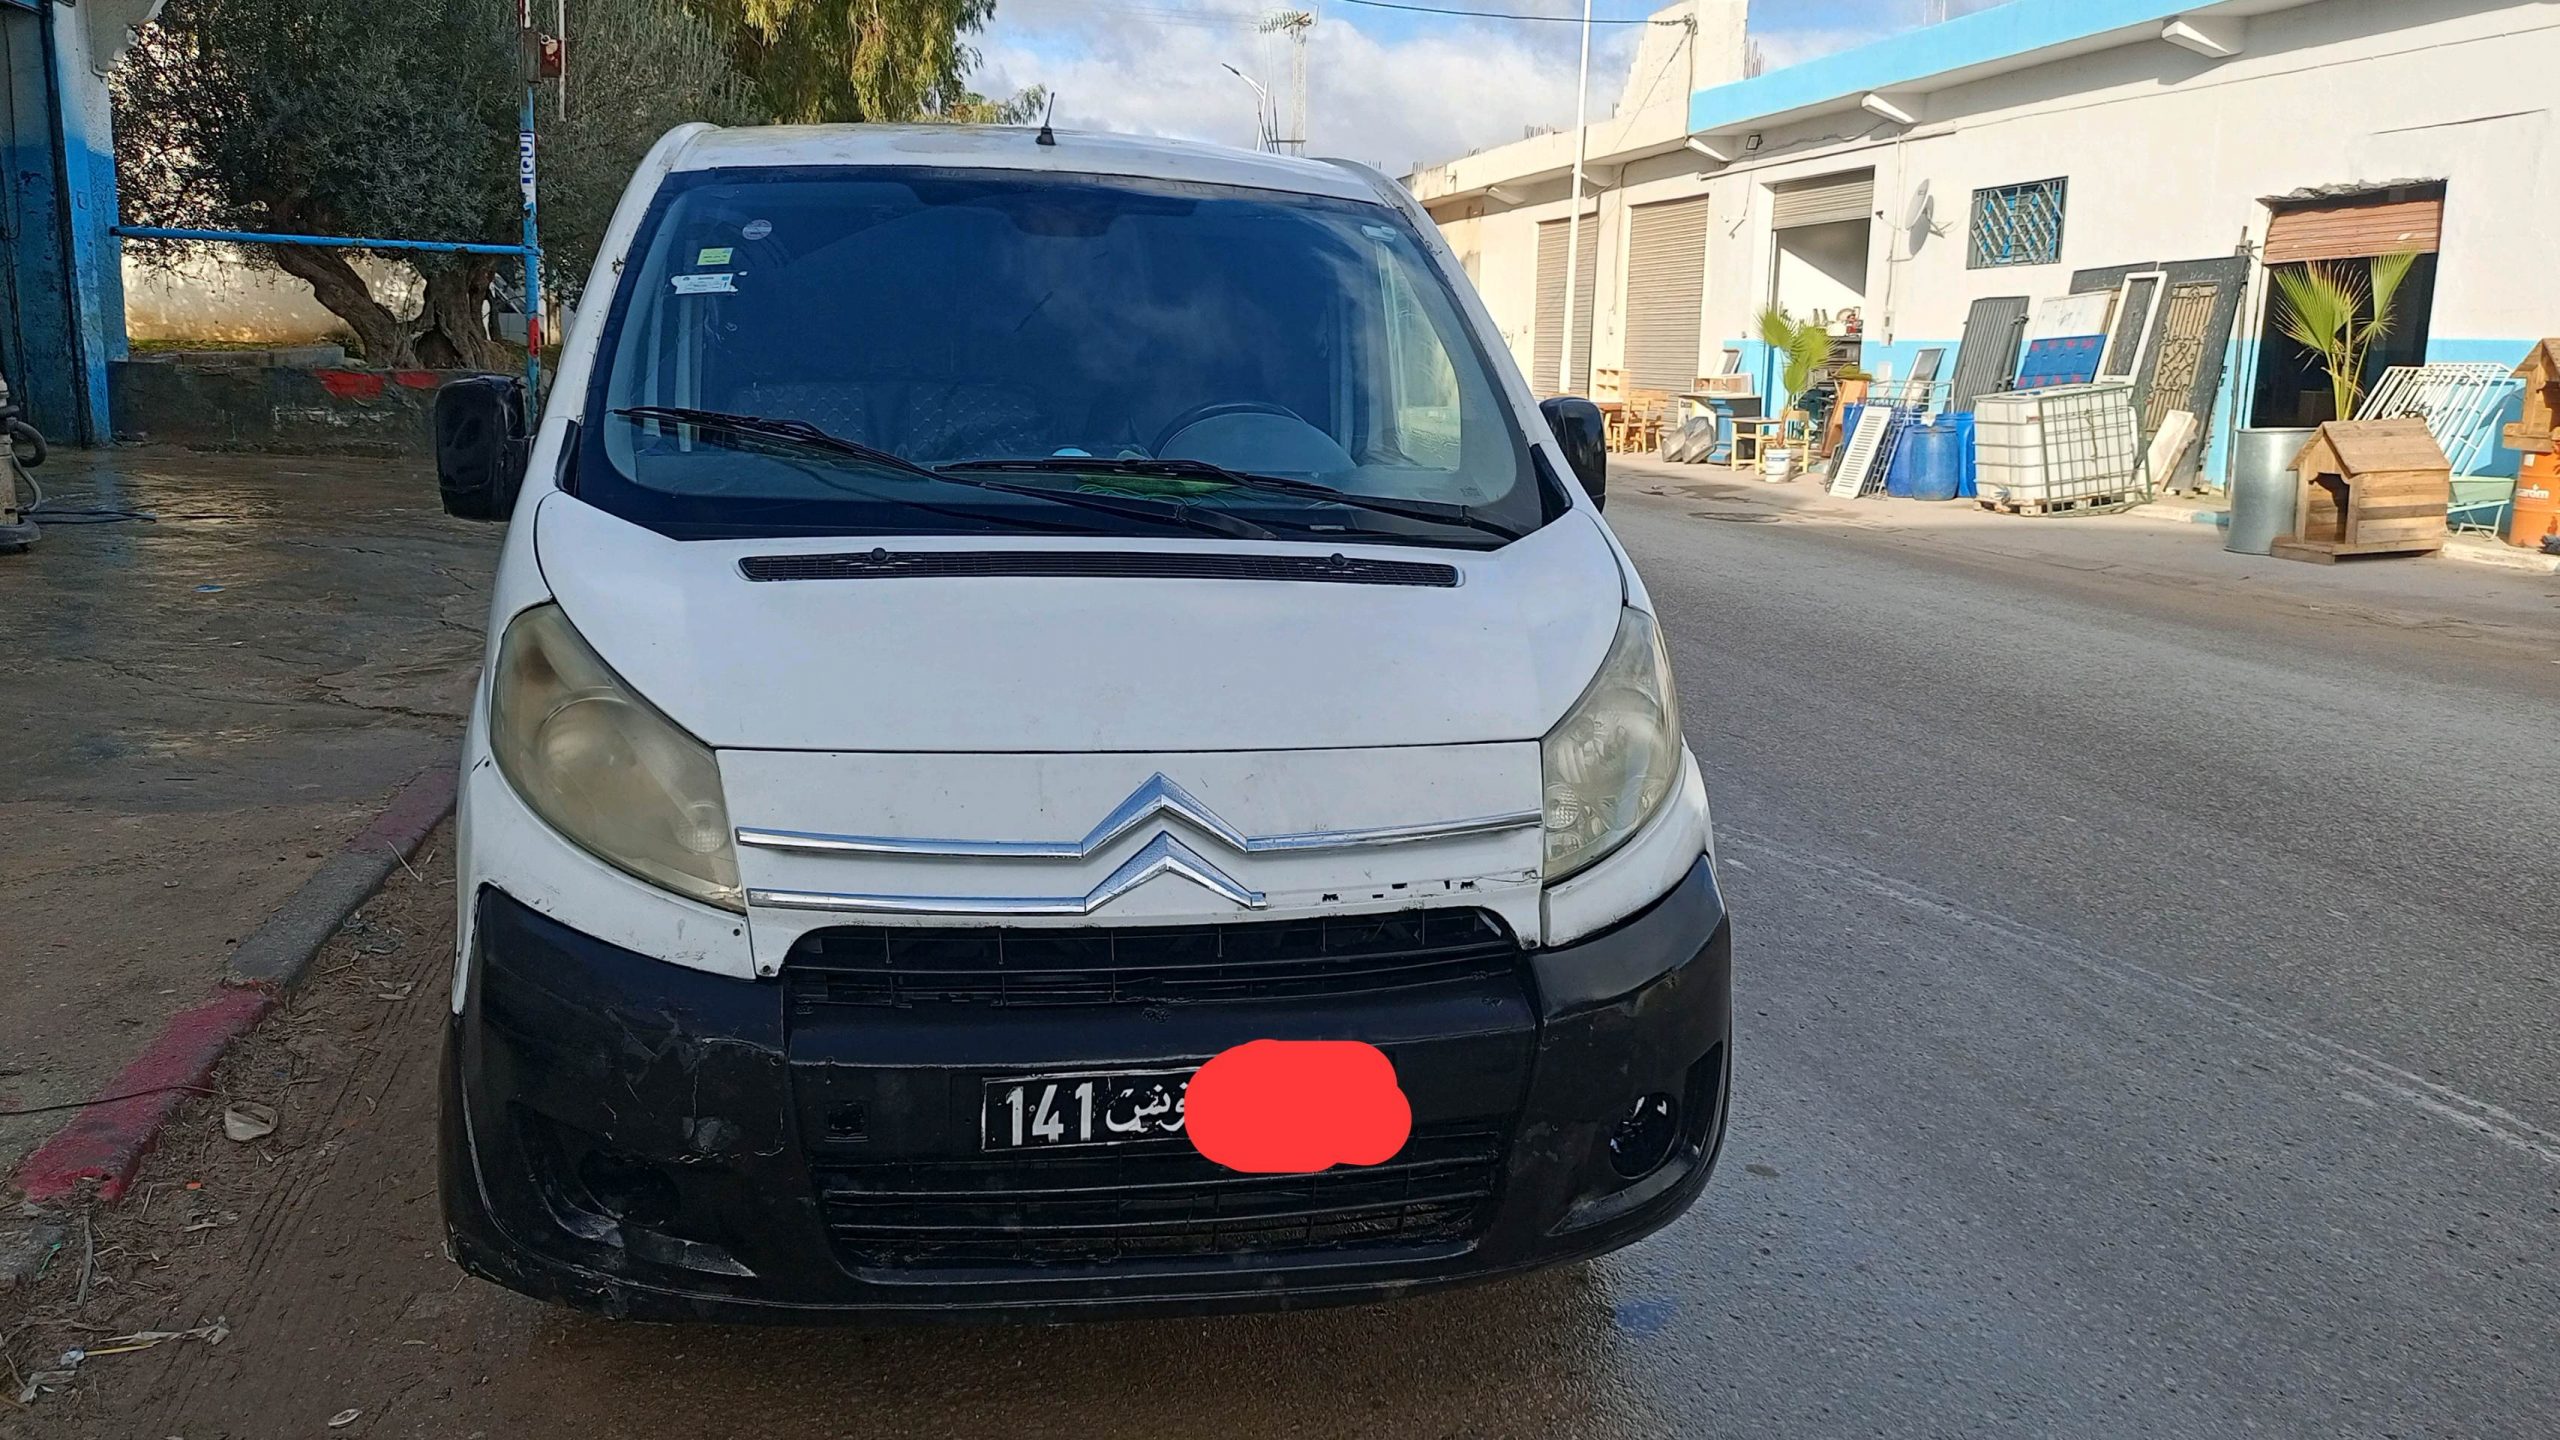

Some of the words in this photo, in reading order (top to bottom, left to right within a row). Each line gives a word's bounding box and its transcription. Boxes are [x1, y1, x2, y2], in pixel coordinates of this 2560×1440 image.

[520, 135, 535, 186] LIQUI
[1005, 1081, 1093, 1146] 141
[1105, 1081, 1188, 1133] ونس
